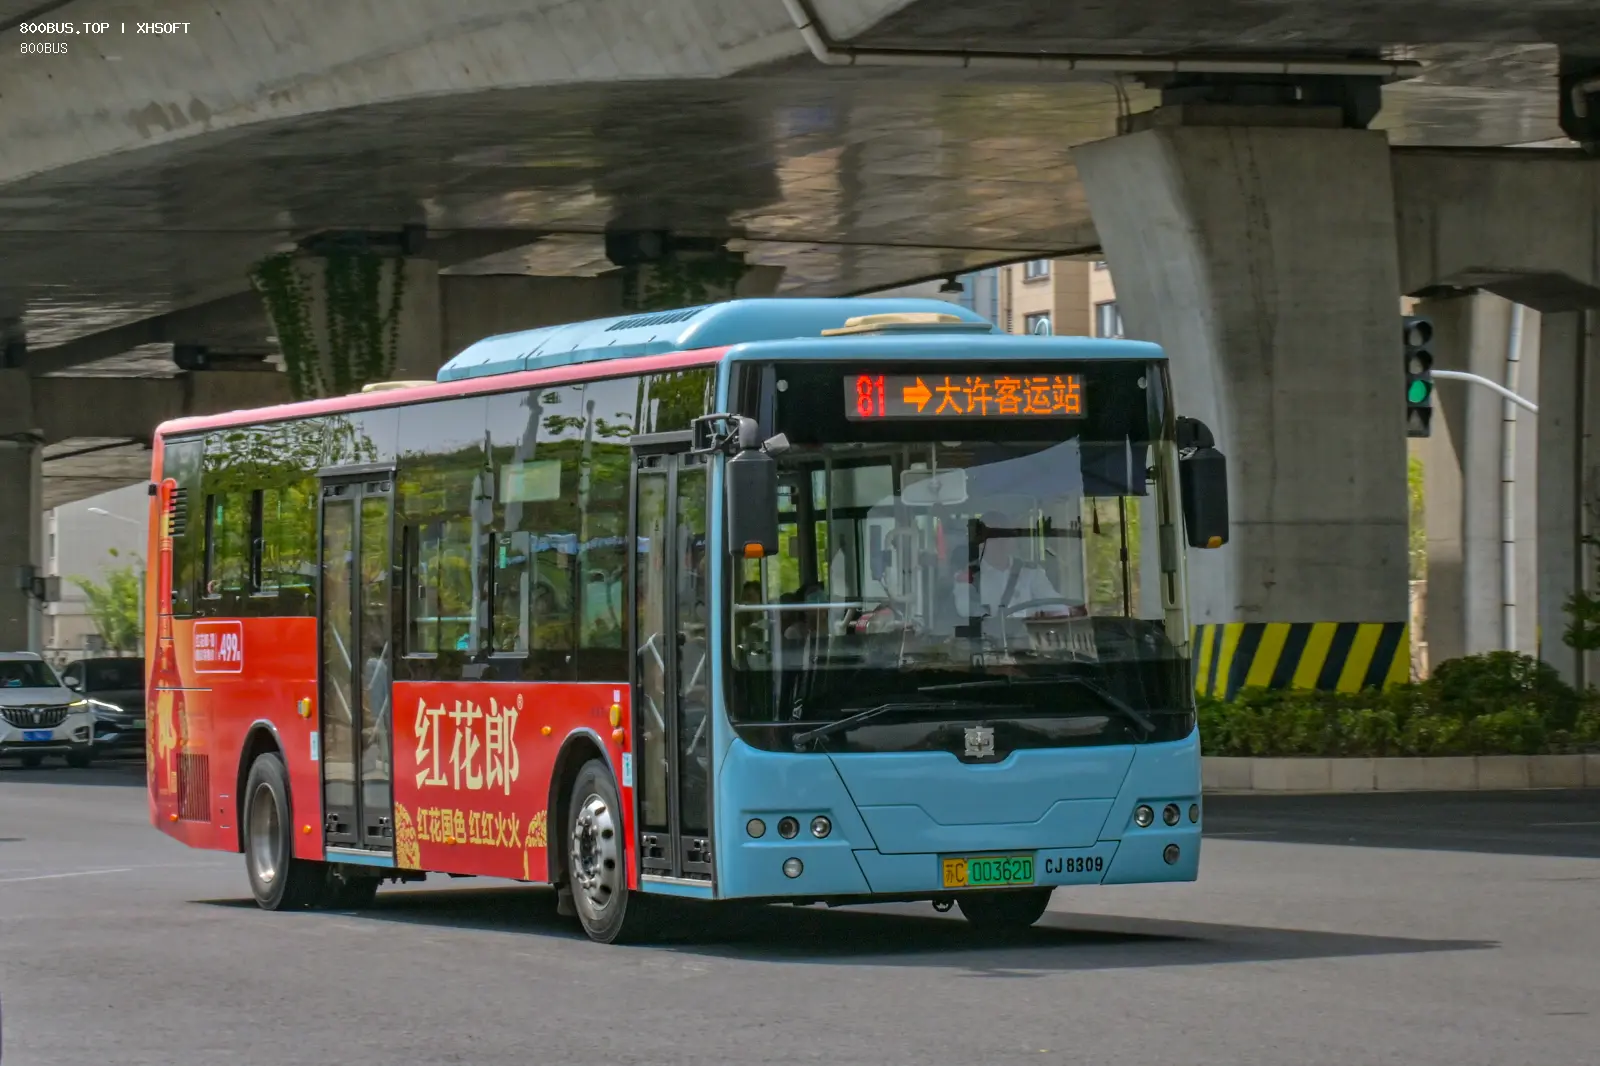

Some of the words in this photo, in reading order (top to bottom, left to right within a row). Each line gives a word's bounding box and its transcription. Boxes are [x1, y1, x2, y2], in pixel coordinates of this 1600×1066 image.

[855, 374, 886, 418] 81
[934, 375, 1081, 417] 大许客运站
[414, 696, 520, 796] 红花郎
[468, 809, 521, 849] 红红火火
